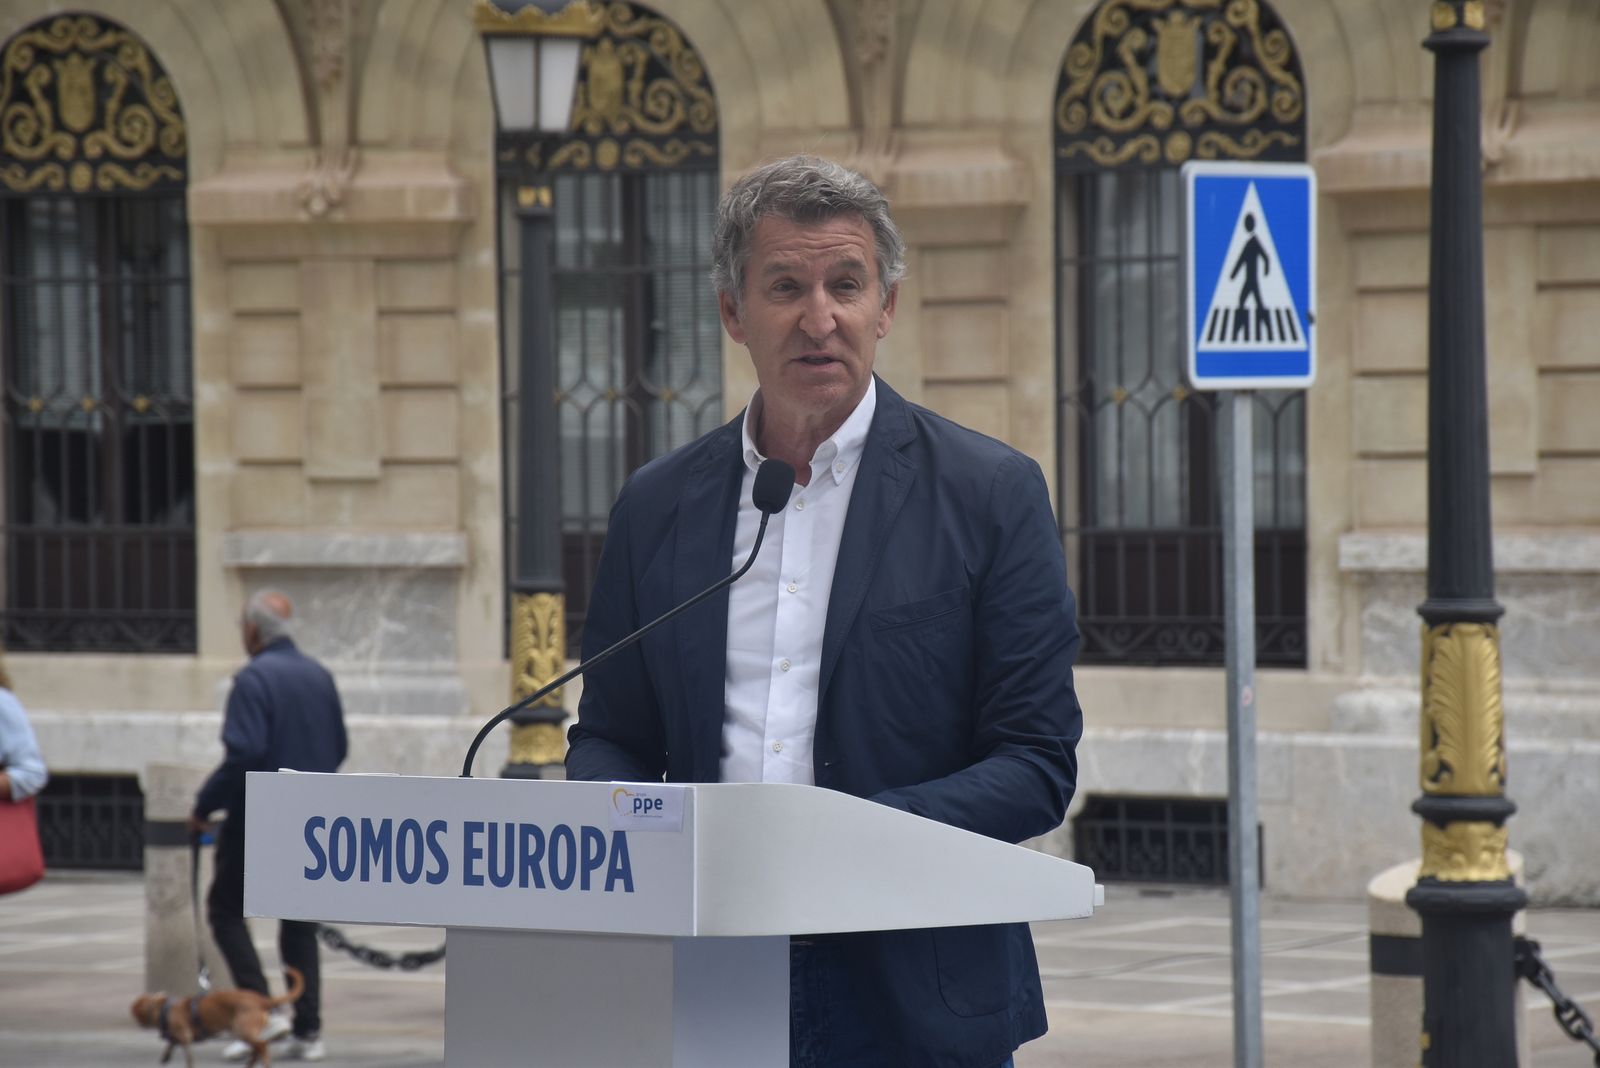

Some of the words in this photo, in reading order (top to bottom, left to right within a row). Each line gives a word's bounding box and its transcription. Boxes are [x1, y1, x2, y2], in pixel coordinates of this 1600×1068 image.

[633, 797, 663, 814] ppe
[303, 815, 449, 886] SOMOS
[464, 821, 635, 893] EUROPA
